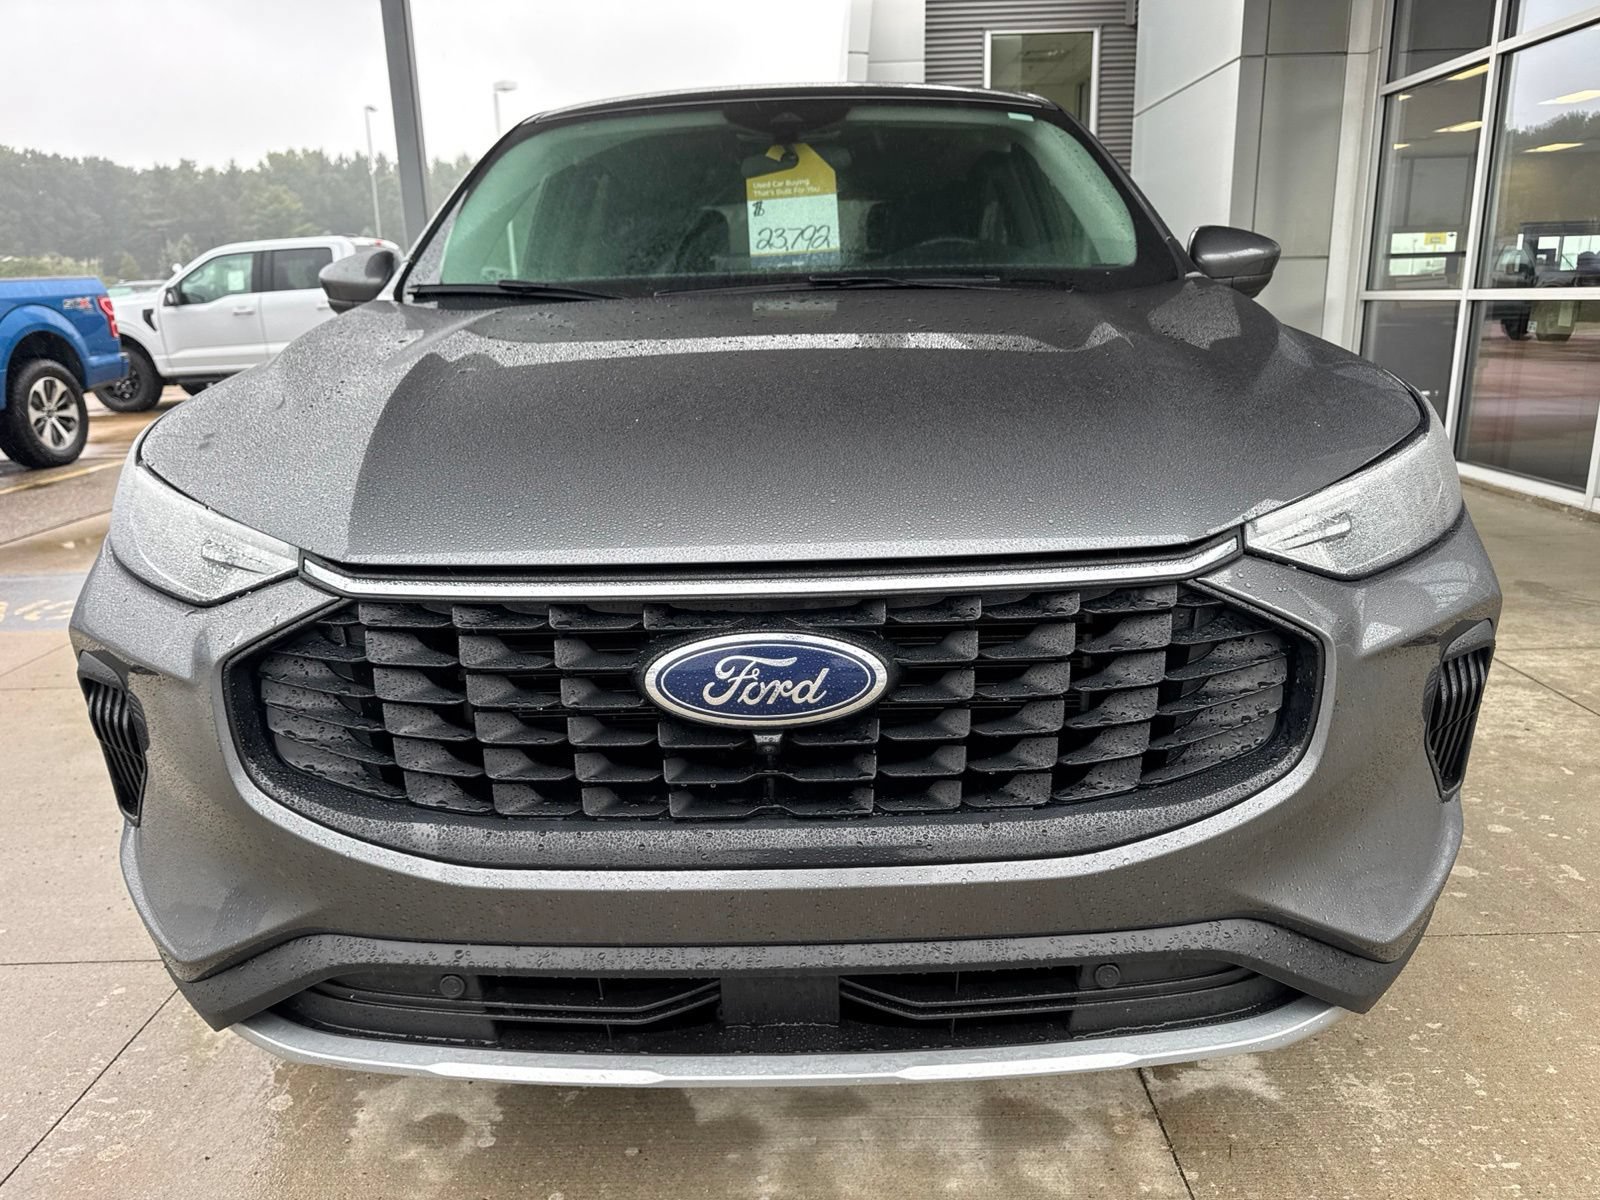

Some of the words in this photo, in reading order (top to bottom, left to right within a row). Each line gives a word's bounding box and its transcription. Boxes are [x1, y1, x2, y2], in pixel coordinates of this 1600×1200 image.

[752, 181, 771, 189] Used
[772, 180, 785, 188] Car
[702, 655, 830, 706] Ford
